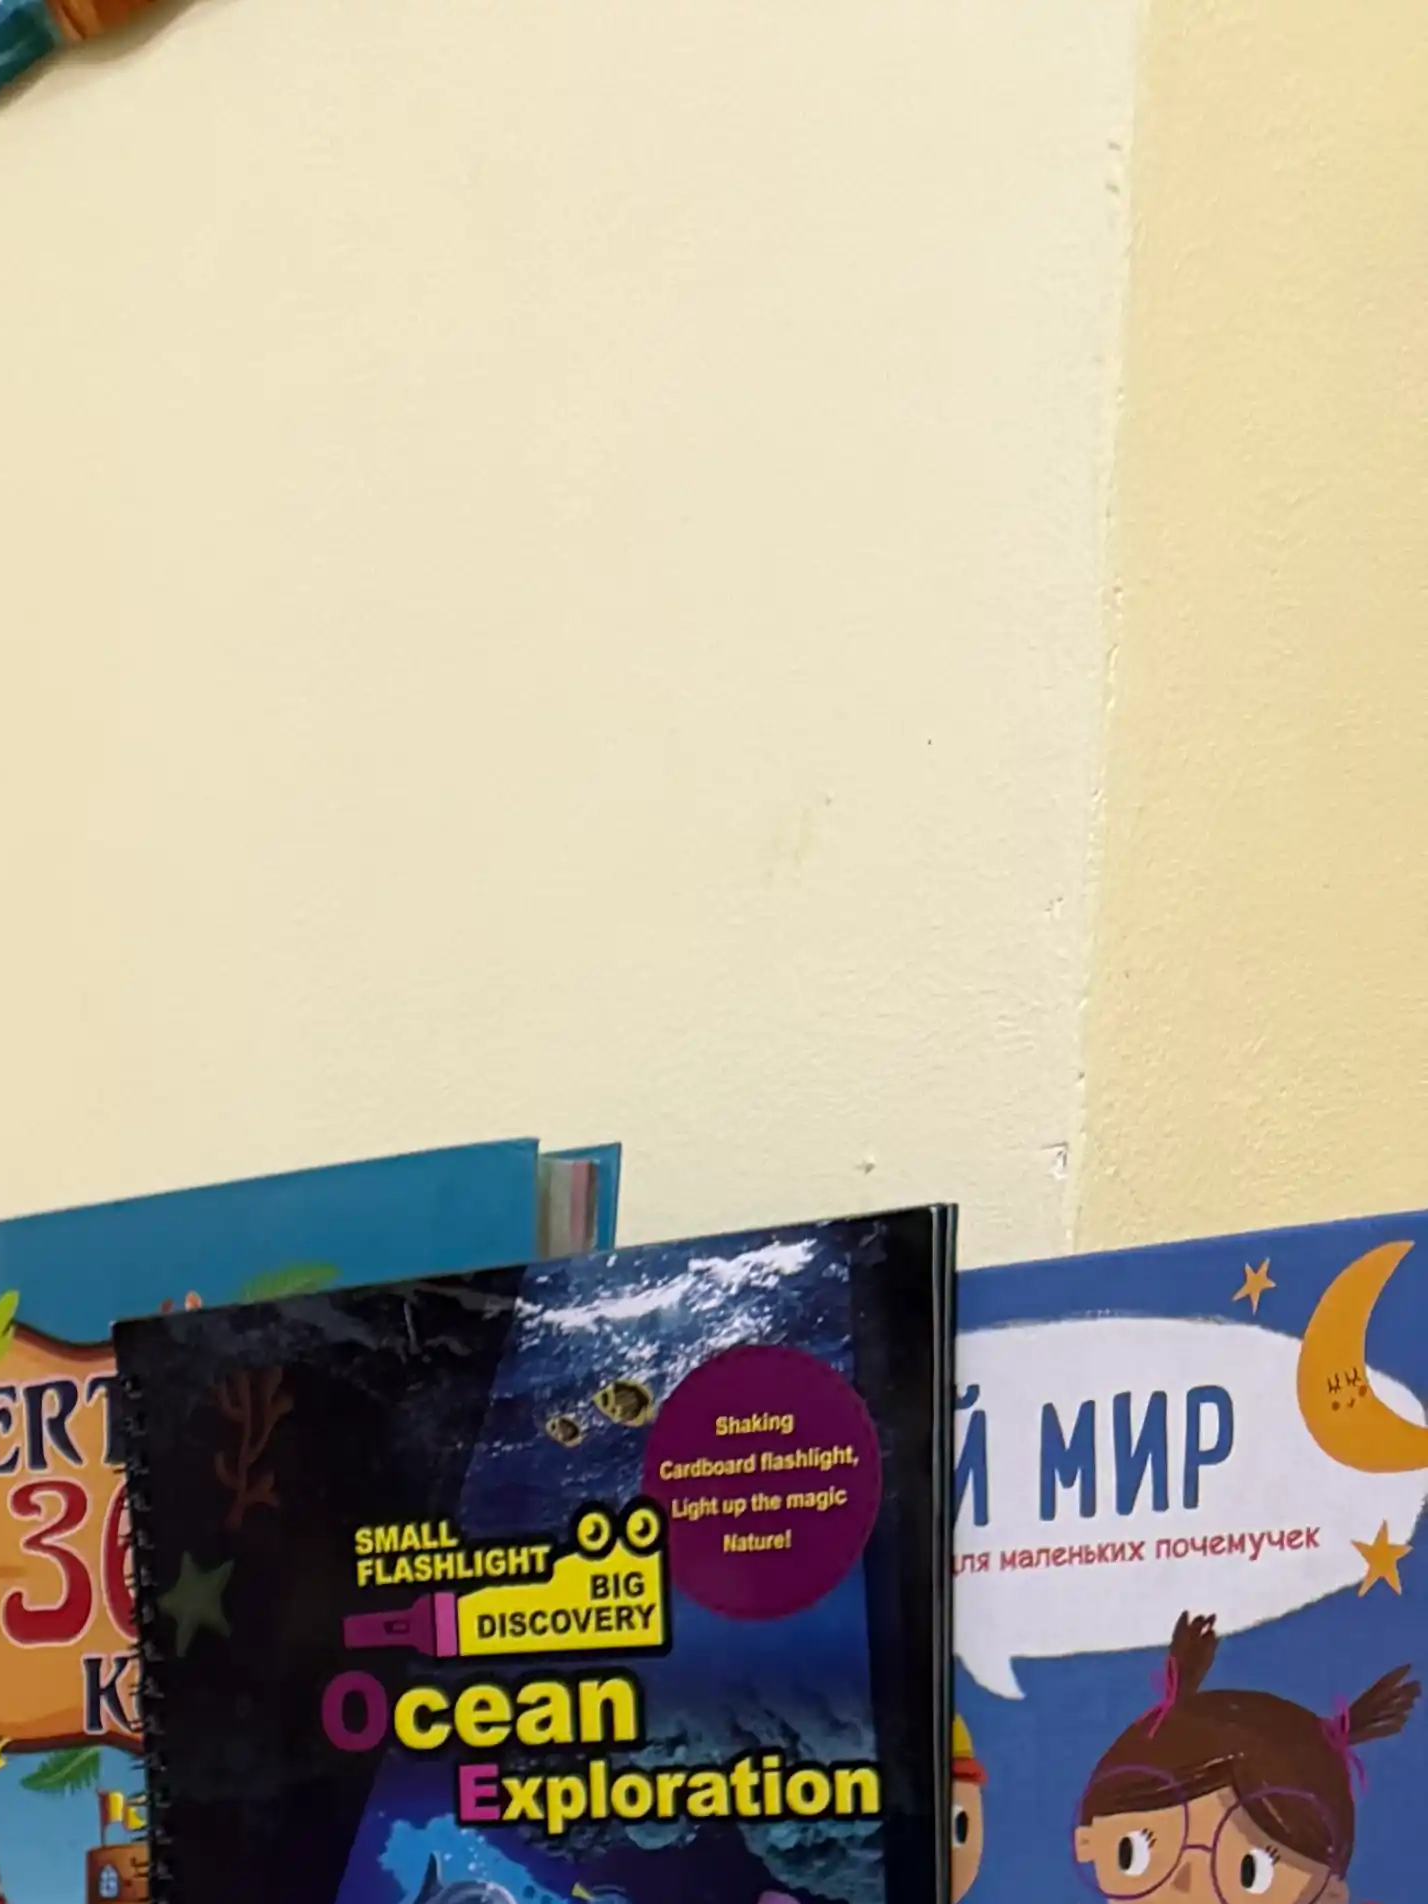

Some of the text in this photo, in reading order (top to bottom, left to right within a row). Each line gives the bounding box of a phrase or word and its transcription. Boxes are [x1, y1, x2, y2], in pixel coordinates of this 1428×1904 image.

[715, 1413, 795, 1437] Shaking
[659, 1445, 859, 1481] Cardboard flashlight,
[1039, 1385, 1234, 1521] МИР
[671, 1486, 848, 1521] Light up the magic
[354, 1520, 459, 1555] SMALL
[723, 1529, 793, 1553] Nature!
[999, 1537, 1145, 1573] маленьких
[1155, 1523, 1320, 1564] почемучек
[356, 1545, 552, 1588] FLASHLIGHT
[590, 1571, 645, 1601] BIG
[477, 1603, 657, 1639] DISCOVERY
[82, 1653, 142, 1734] K
[321, 1669, 640, 1751] Ocean
[458, 1754, 881, 1834] Exploration
